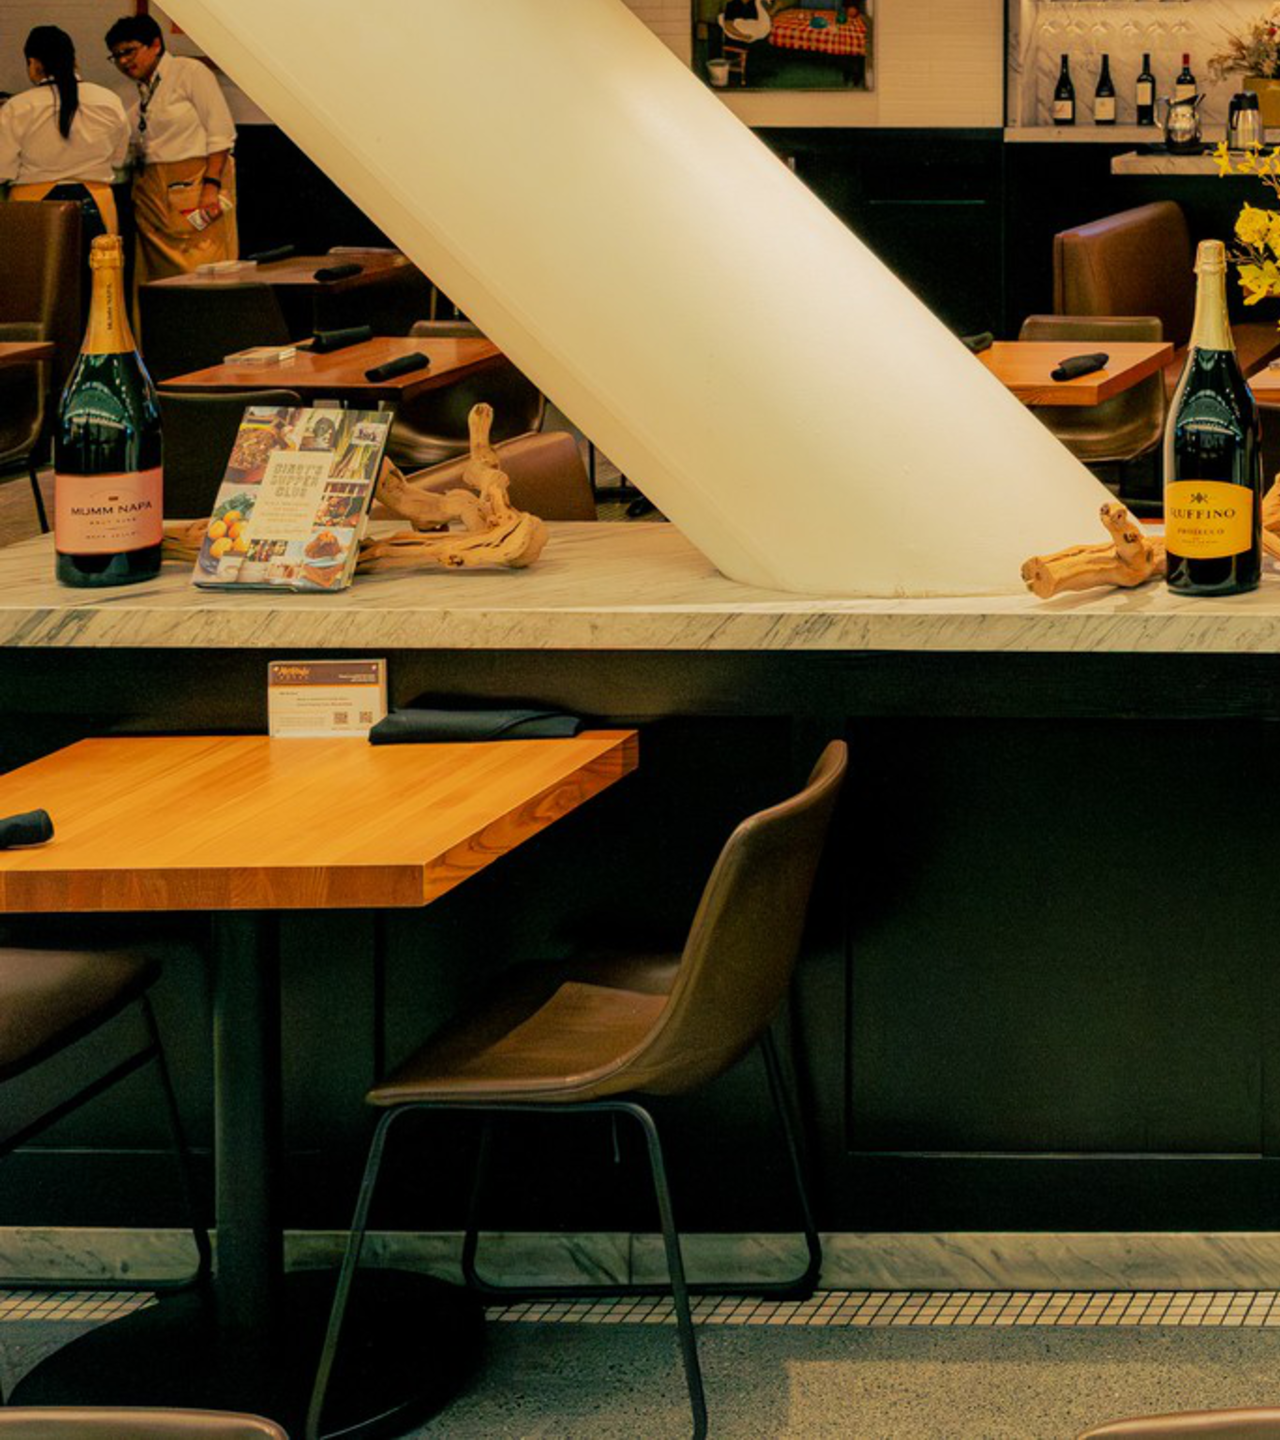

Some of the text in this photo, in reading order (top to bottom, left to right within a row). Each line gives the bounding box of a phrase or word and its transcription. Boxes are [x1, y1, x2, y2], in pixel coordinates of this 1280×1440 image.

[69, 499, 153, 517] MUMM NAPA
[1169, 507, 1237, 520] RUFFINO
